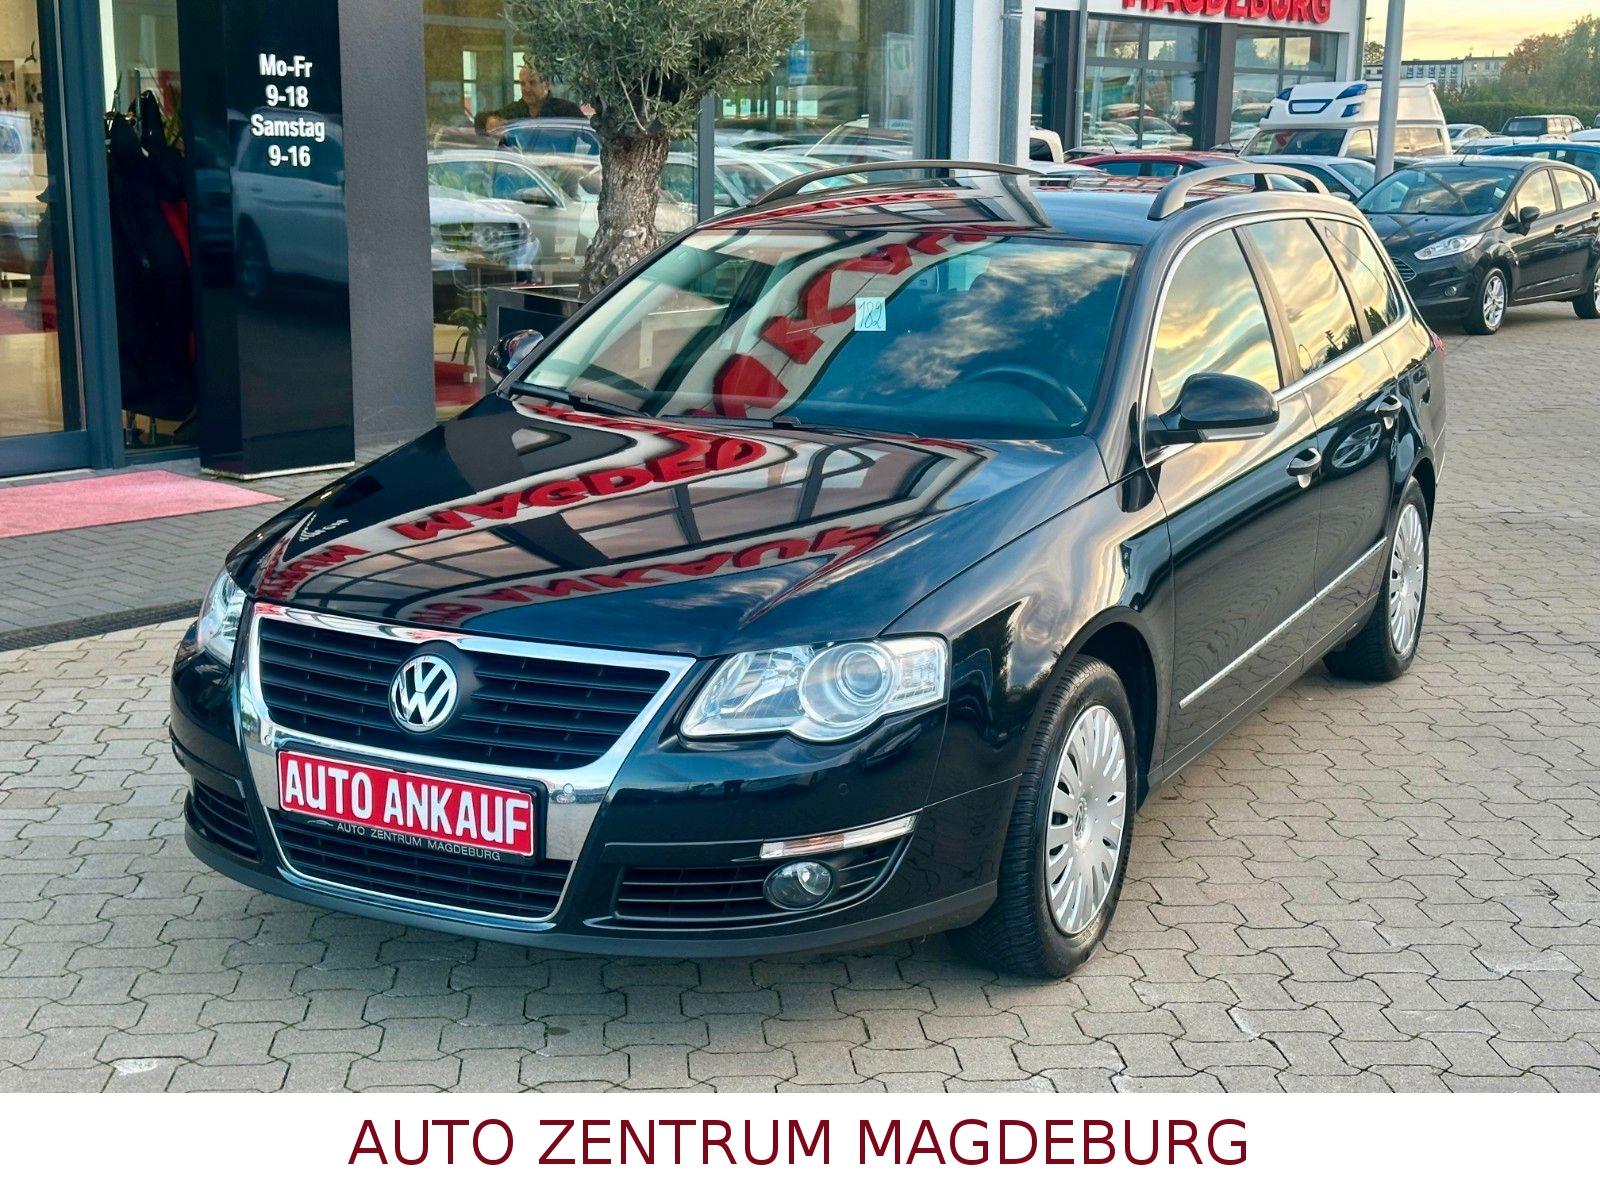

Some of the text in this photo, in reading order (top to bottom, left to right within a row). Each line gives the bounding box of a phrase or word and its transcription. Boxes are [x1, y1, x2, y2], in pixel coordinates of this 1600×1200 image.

[1121, 0, 1331, 24] DEBURG
[258, 53, 313, 78] Mo-Fr
[265, 84, 309, 108] 9-18
[250, 113, 325, 143] Samstag
[268, 144, 311, 167] 9-16
[284, 759, 529, 845] AUTO ANKAUF
[336, 822, 501, 861] AUTO ZENTRUM MAGDEBURG
